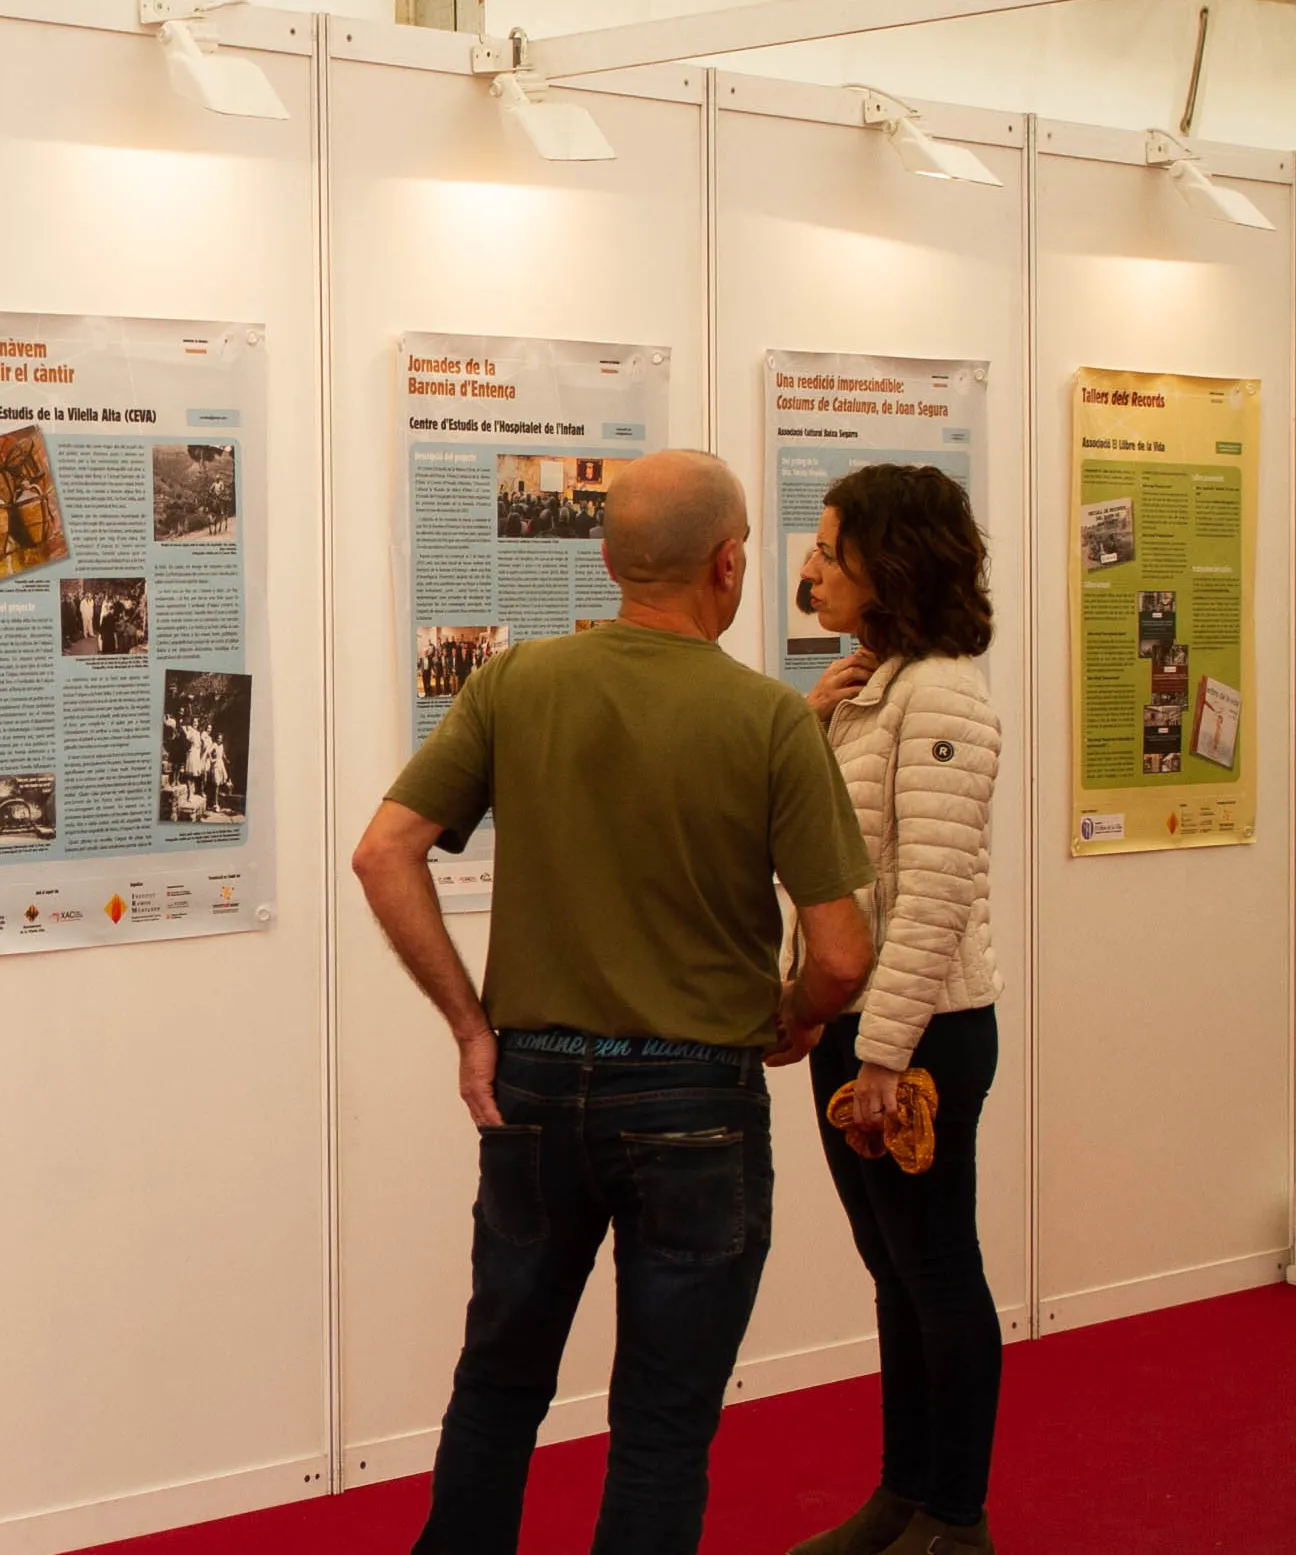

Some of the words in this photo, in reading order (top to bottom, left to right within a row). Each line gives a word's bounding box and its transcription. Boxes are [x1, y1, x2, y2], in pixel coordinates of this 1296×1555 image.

[15, 363, 27, 382] el
[34, 364, 74, 383] càntir
[408, 355, 461, 374] Jornades
[466, 358, 480, 374] de
[485, 359, 495, 375] la
[409, 377, 455, 396] Baronia
[460, 380, 515, 400] d'Entença
[777, 373, 794, 388] Una
[798, 375, 834, 390] reedició
[837, 376, 904, 393] imprescindible:
[777, 395, 815, 410] Costums
[818, 397, 829, 411] de
[833, 397, 878, 415] Catalunya,
[882, 400, 892, 414] de
[896, 401, 915, 415] Joan
[918, 401, 948, 417] Segura
[1082, 388, 1109, 404] Tallers
[1111, 390, 1129, 406] dels
[1131, 392, 1165, 408] Records
[37, 408, 50, 420] de
[54, 407, 64, 420] la
[68, 408, 98, 421] Vilella
[102, 409, 121, 422] Alta
[125, 409, 156, 423] (CEVA)
[410, 417, 438, 430] Centre
[441, 418, 478, 431] d'Estudis
[481, 420, 491, 432] de
[495, 420, 541, 434] l'Hospitalet
[545, 423, 554, 434] de
[557, 423, 584, 435] l'Infant
[778, 428, 803, 436] Associació
[804, 429, 822, 437] Cultural
[824, 429, 837, 437] Baixa
[839, 430, 858, 438] Segarra
[1082, 437, 1111, 448] Associació
[1112, 439, 1117, 450] El
[1119, 440, 1135, 450] Llibre
[1137, 442, 1145, 451] de
[1147, 442, 1152, 451] la
[1153, 442, 1165, 452] Vida
[939, 747, 947, 755] R
